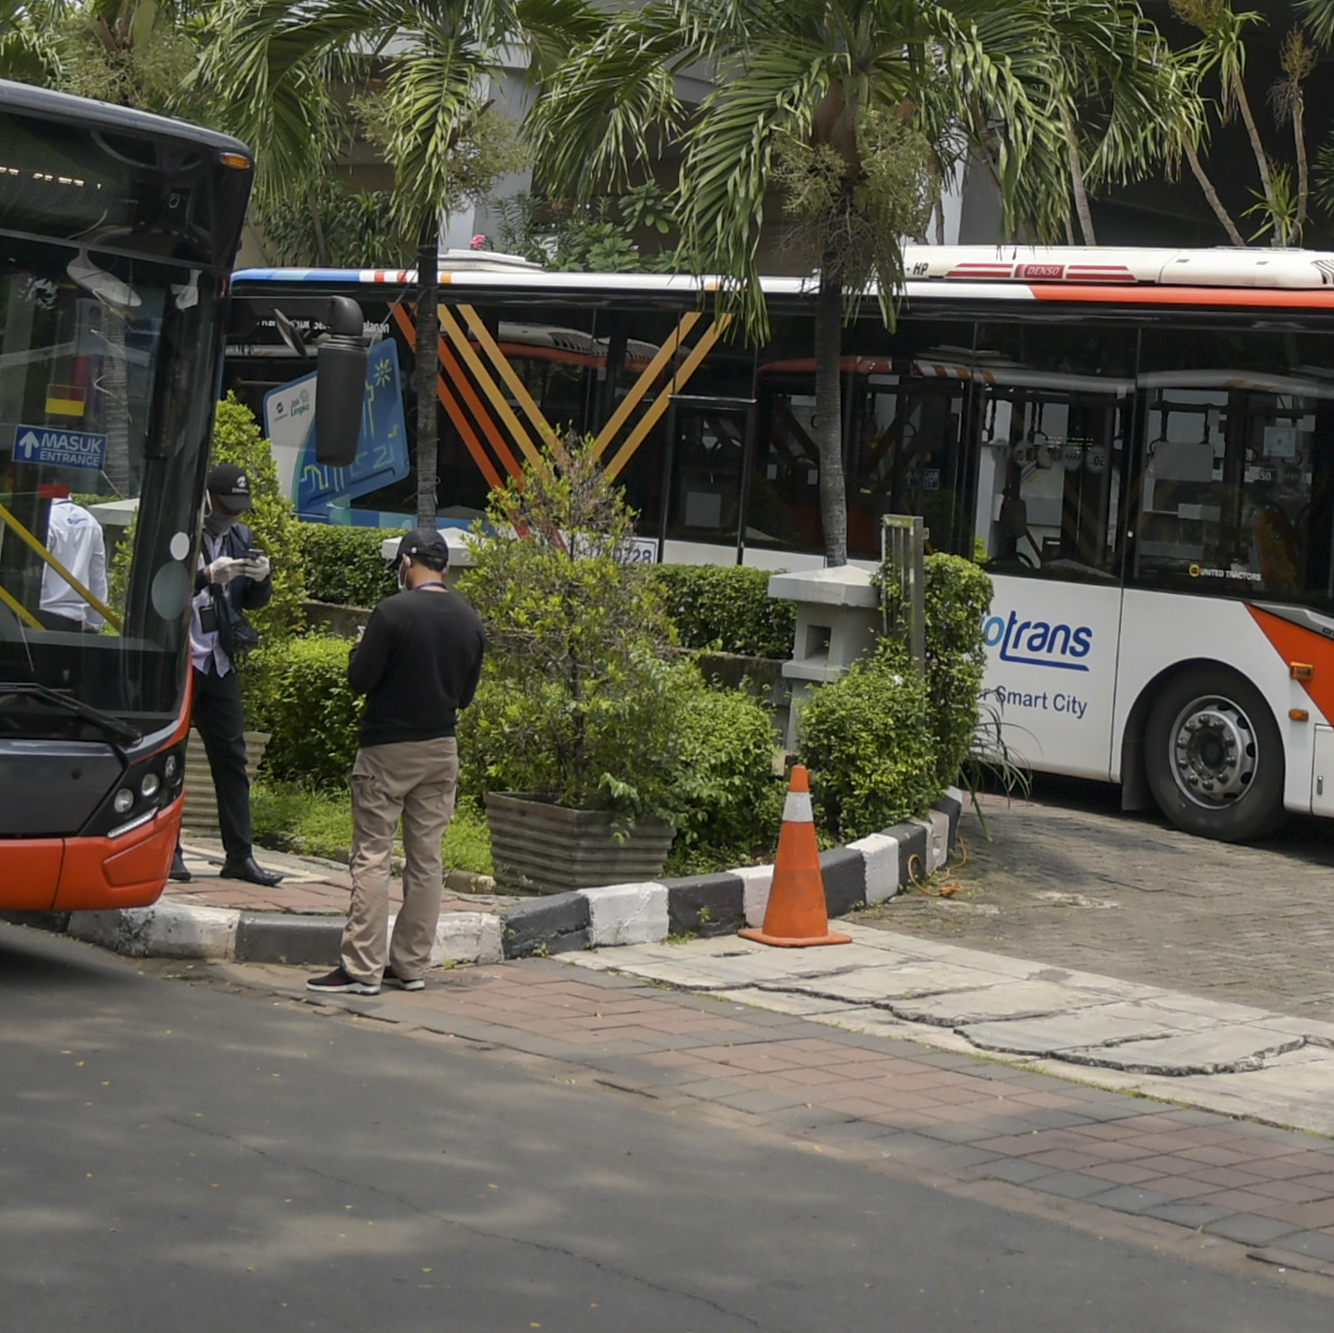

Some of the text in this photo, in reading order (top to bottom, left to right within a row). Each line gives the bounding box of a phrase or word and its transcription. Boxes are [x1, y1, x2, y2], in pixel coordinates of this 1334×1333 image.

[1027, 266, 1060, 275] DENSO
[41, 433, 102, 454] MASUK
[39, 451, 100, 467] ENTRANCE
[1200, 568, 1262, 581] UNITED TRACTORS
[981, 610, 1093, 660] otrans
[996, 685, 1049, 710] Smart
[1053, 693, 1088, 719] City
